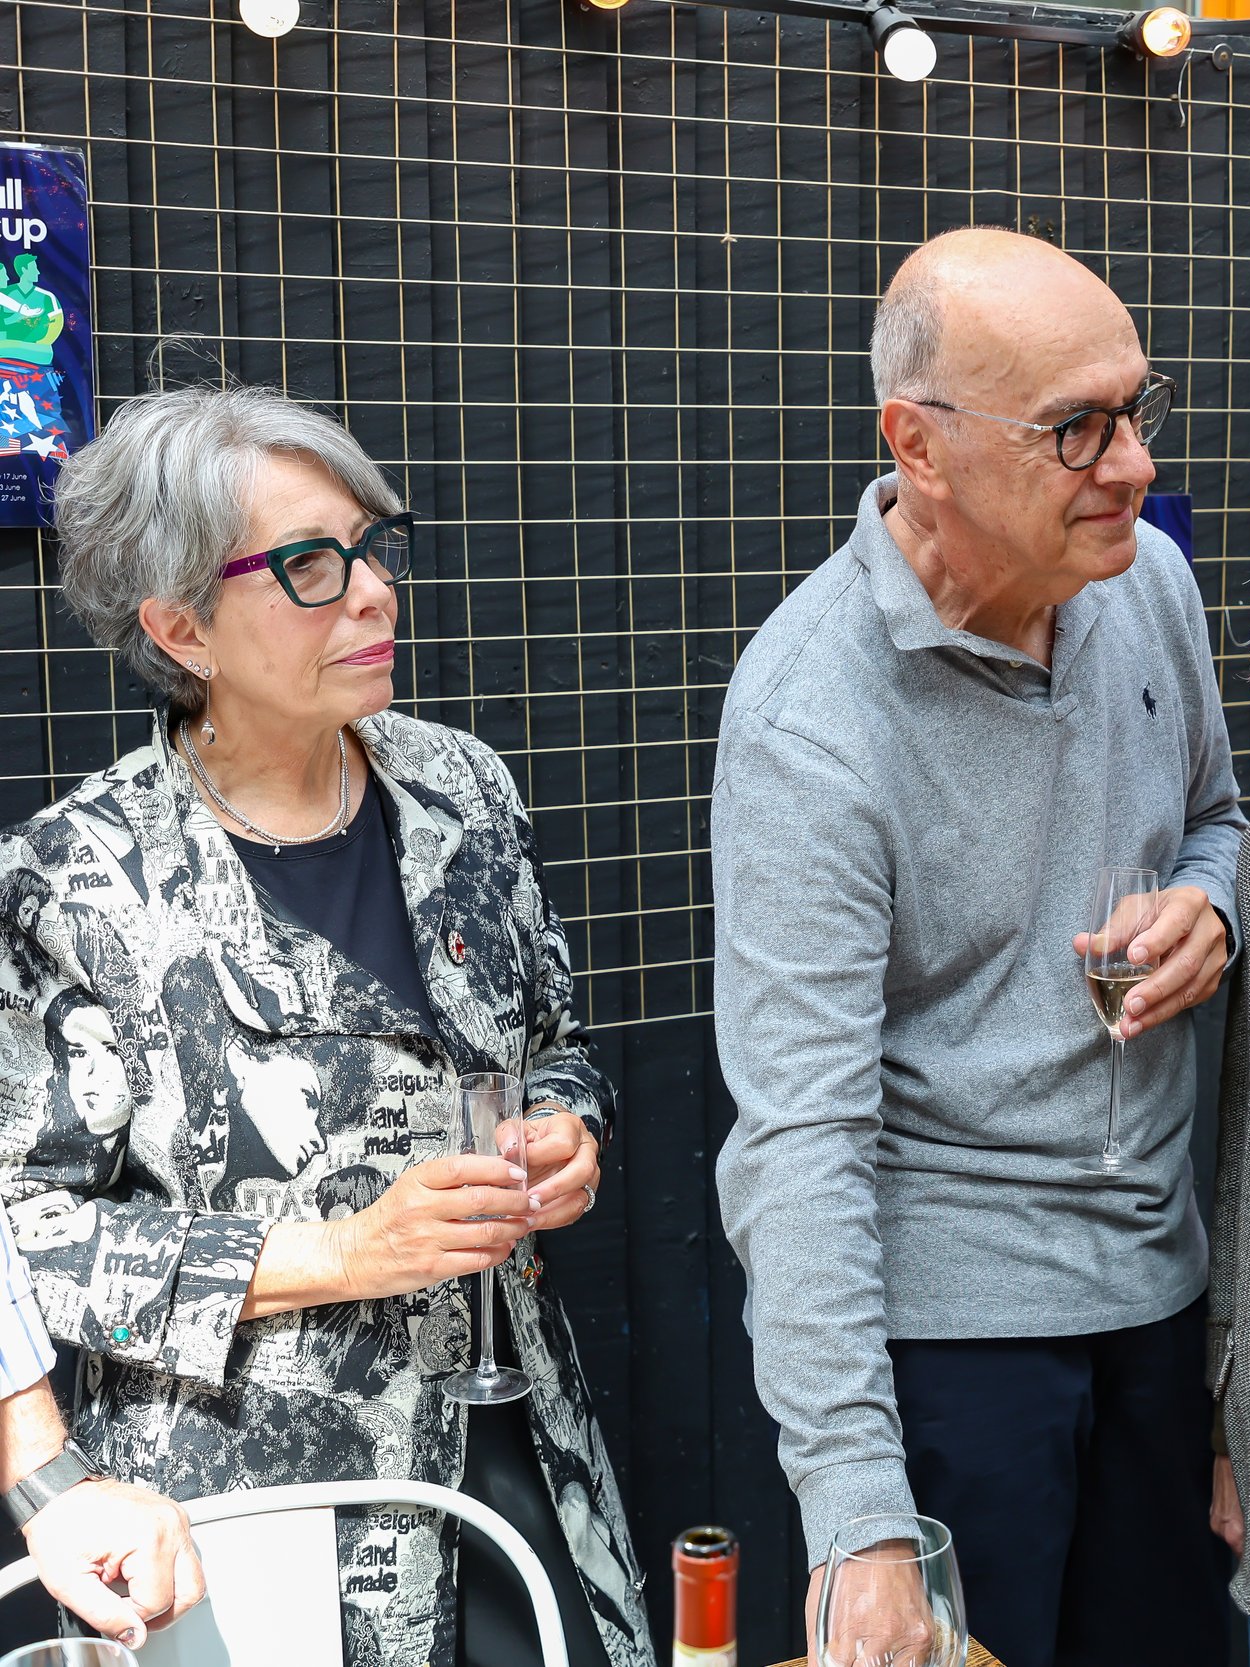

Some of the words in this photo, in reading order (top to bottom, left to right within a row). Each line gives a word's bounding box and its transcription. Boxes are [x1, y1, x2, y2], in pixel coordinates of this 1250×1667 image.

[0, 217, 48, 250] up
[12, 473, 28, 481] June
[364, 1129, 411, 1157] made
[346, 1566, 398, 1594] made
